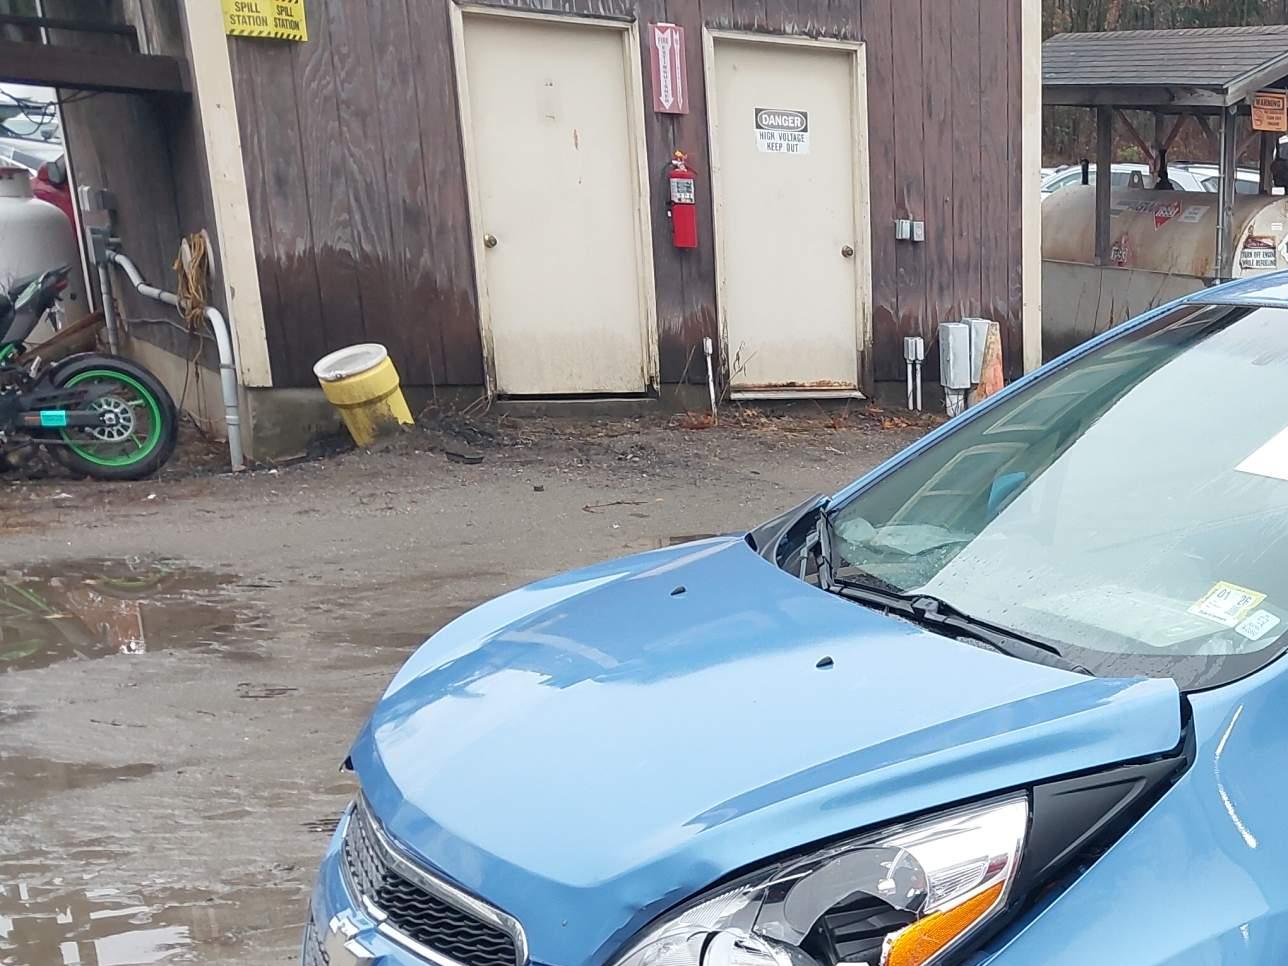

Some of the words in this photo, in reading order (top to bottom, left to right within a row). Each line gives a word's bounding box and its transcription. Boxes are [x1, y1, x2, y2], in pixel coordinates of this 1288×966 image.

[234, 1, 260, 13] SPILL
[276, 5, 294, 17] SPILL
[229, 14, 268, 26] STATION
[274, 17, 300, 31] STATION
[762, 114, 801, 127] DANGER
[760, 131, 775, 140] HIGH
[779, 132, 805, 142] VOLTAGE
[767, 142, 782, 151] KEEP
[786, 143, 799, 152] OUT
